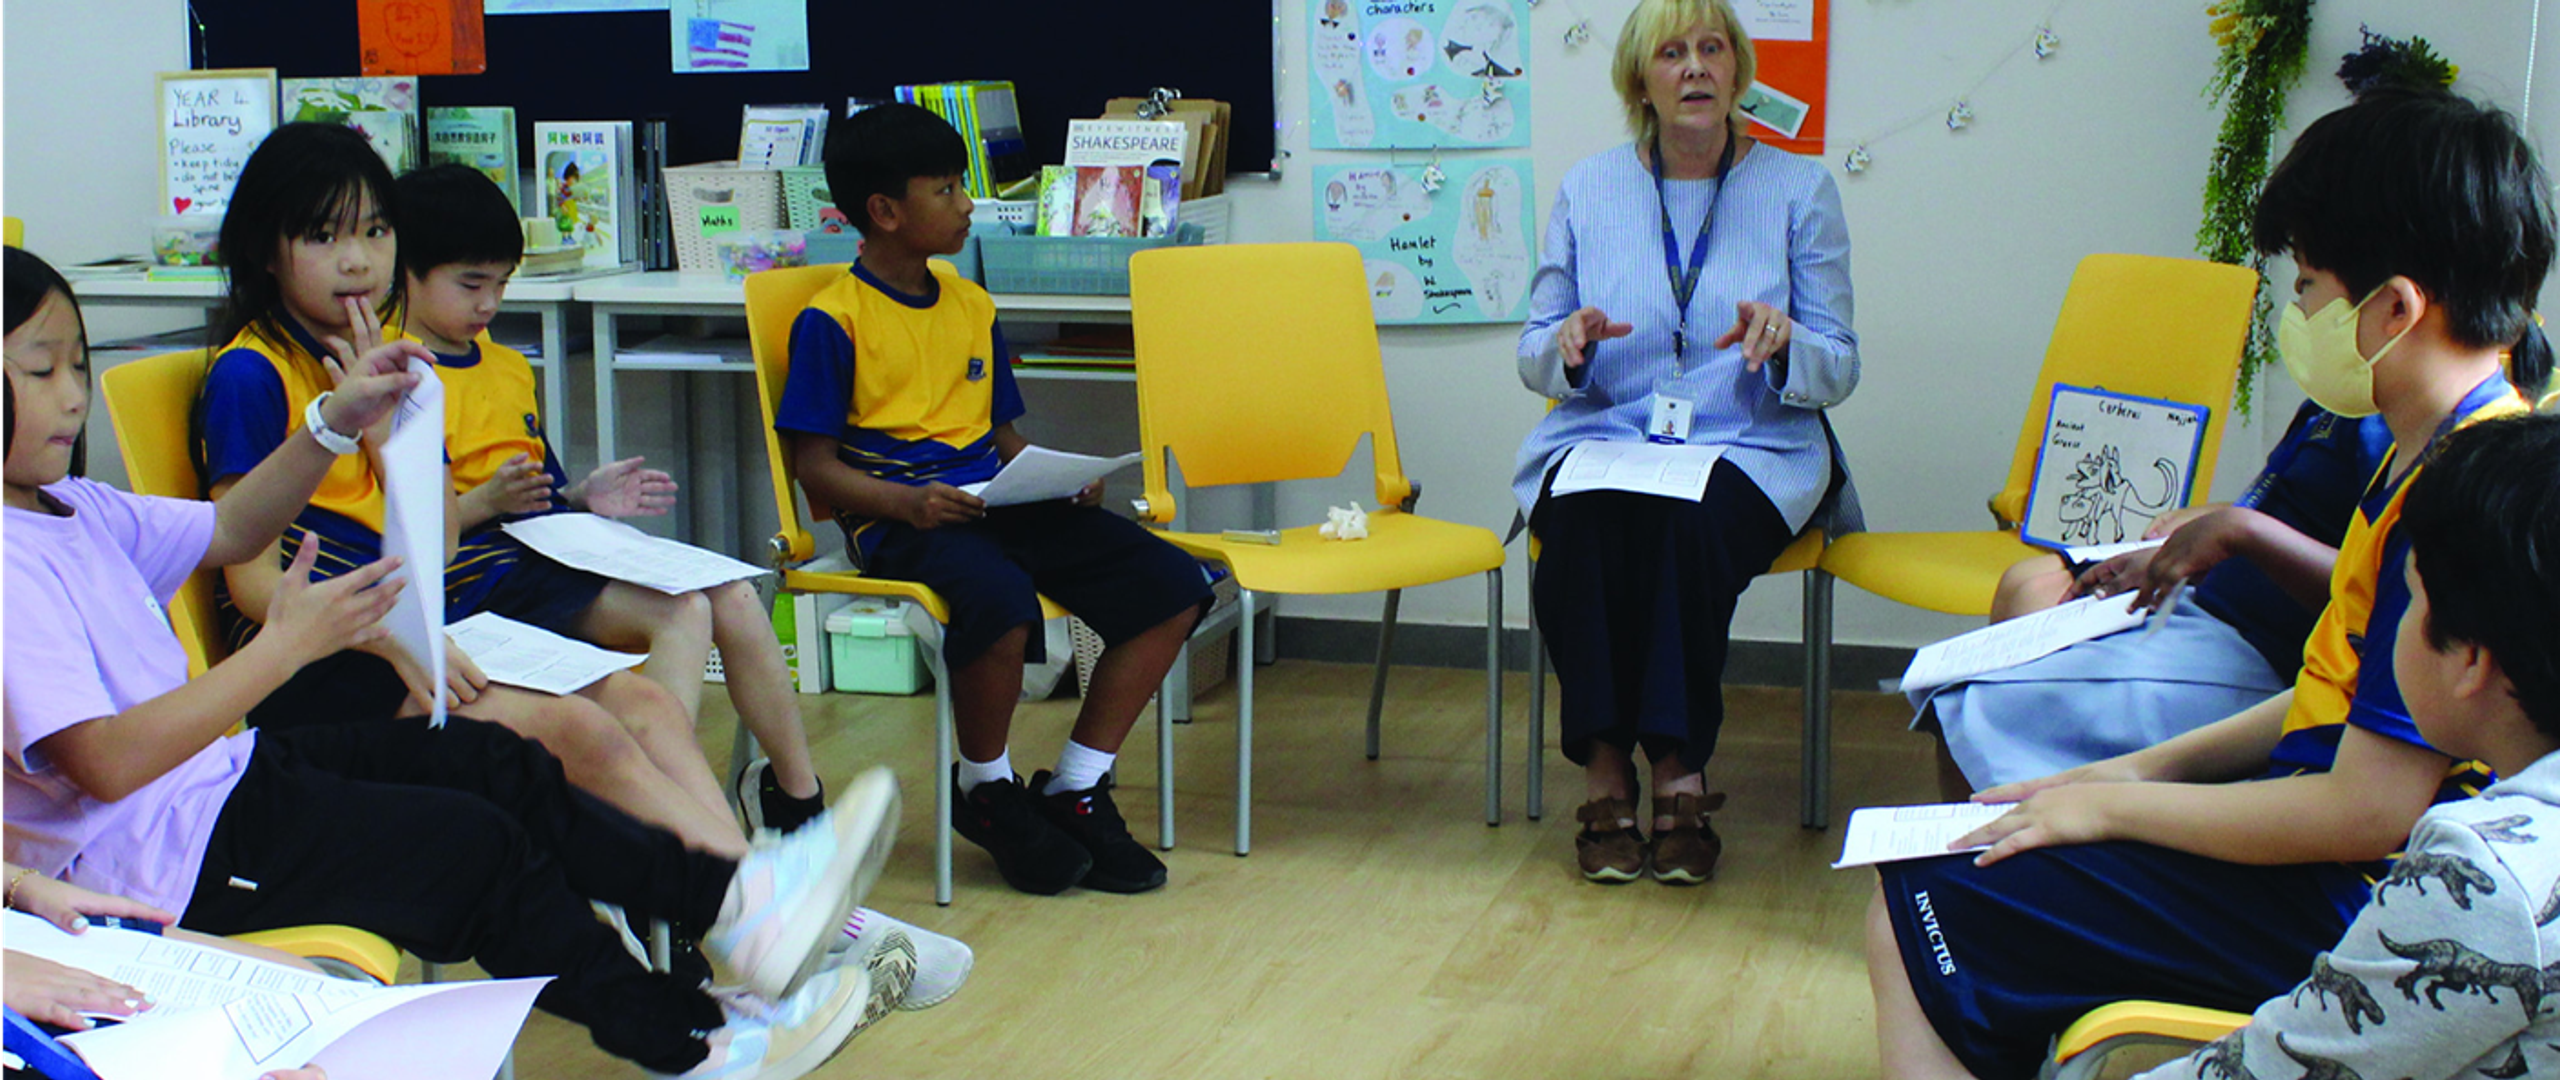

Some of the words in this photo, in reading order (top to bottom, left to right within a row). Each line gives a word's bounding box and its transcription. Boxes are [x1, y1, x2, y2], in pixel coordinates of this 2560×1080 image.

[173, 89, 219, 108] YEAR
[233, 90, 250, 105] 4
[173, 108, 242, 136] Library
[169, 138, 216, 156] Please
[1073, 135, 1180, 151] SHAKESPEARE
[702, 215, 733, 228] Maths
[1390, 236, 1436, 251] Hamlet
[1418, 254, 1434, 267] by
[2056, 419, 2086, 433] Ancient
[1915, 890, 1956, 976] INVICTUS
